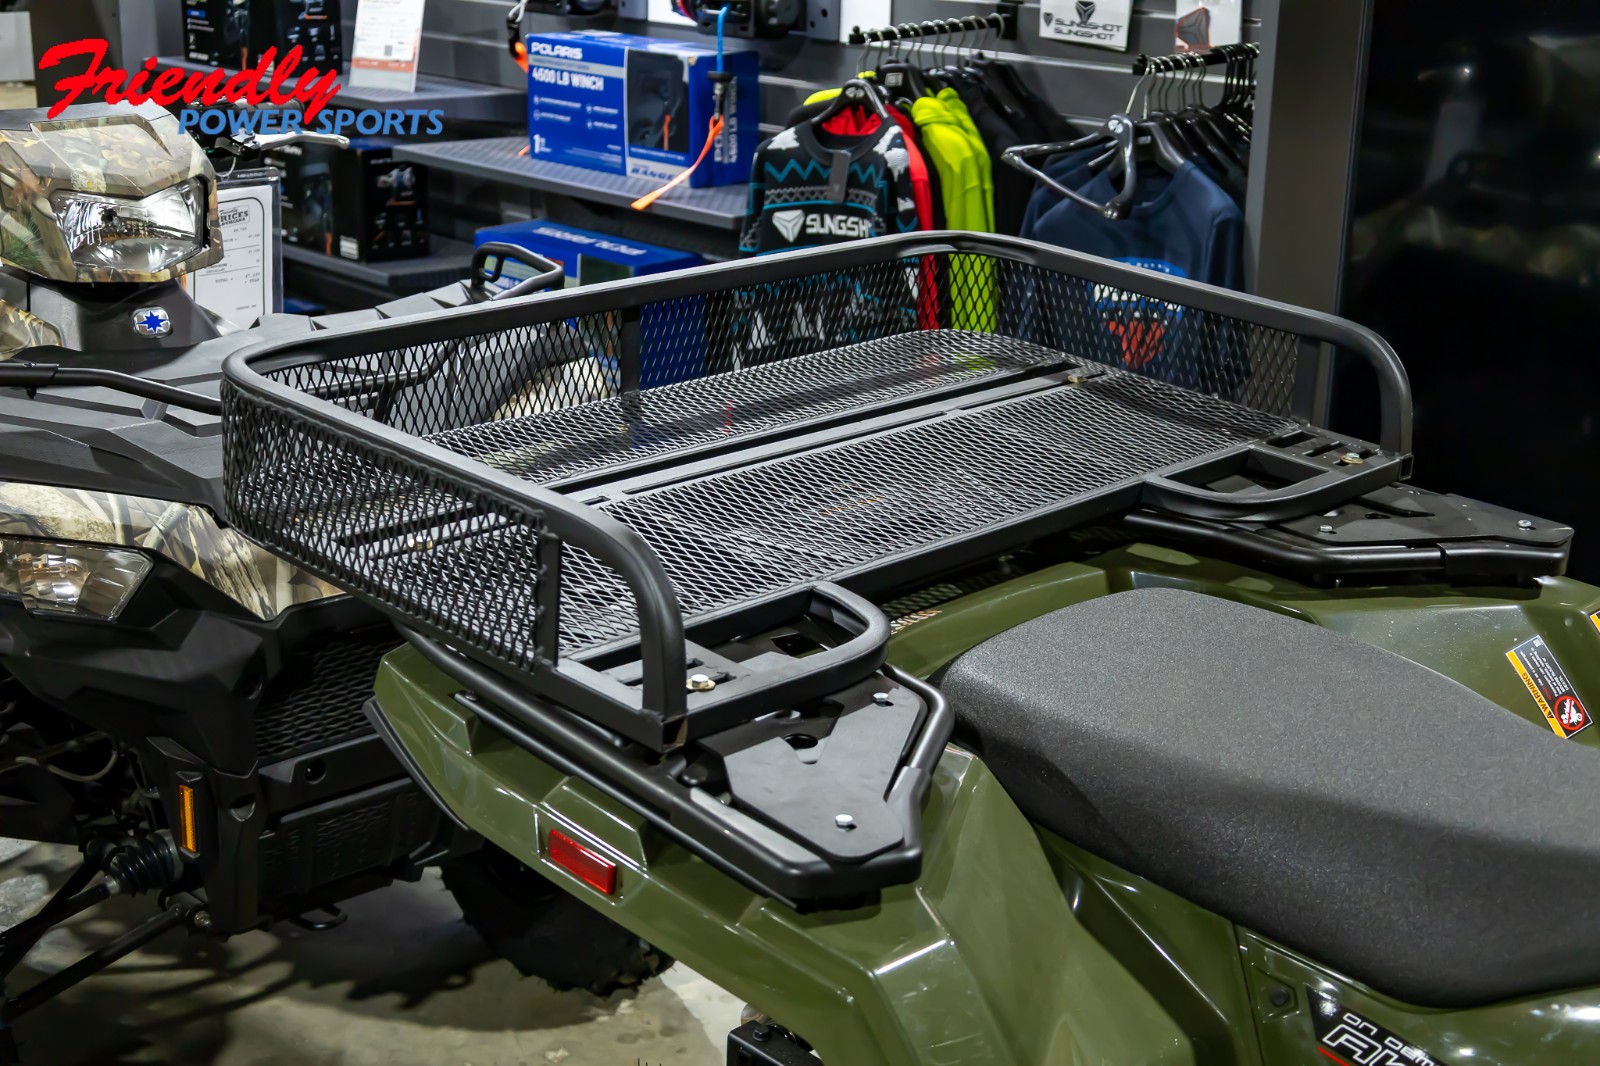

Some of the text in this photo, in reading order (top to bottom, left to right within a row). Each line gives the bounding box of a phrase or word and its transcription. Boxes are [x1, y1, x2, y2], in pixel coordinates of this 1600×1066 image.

[1054, 18, 1123, 33] SLINGSHOT
[1053, 27, 1115, 41] SLINGSHOT
[531, 42, 583, 60] POLARIS
[556, 70, 570, 87] LB
[570, 73, 604, 92] WINCH
[630, 167, 676, 182] RANGE
[220, 210, 249, 222] RICES
[1521, 672, 1548, 711] WARNING
